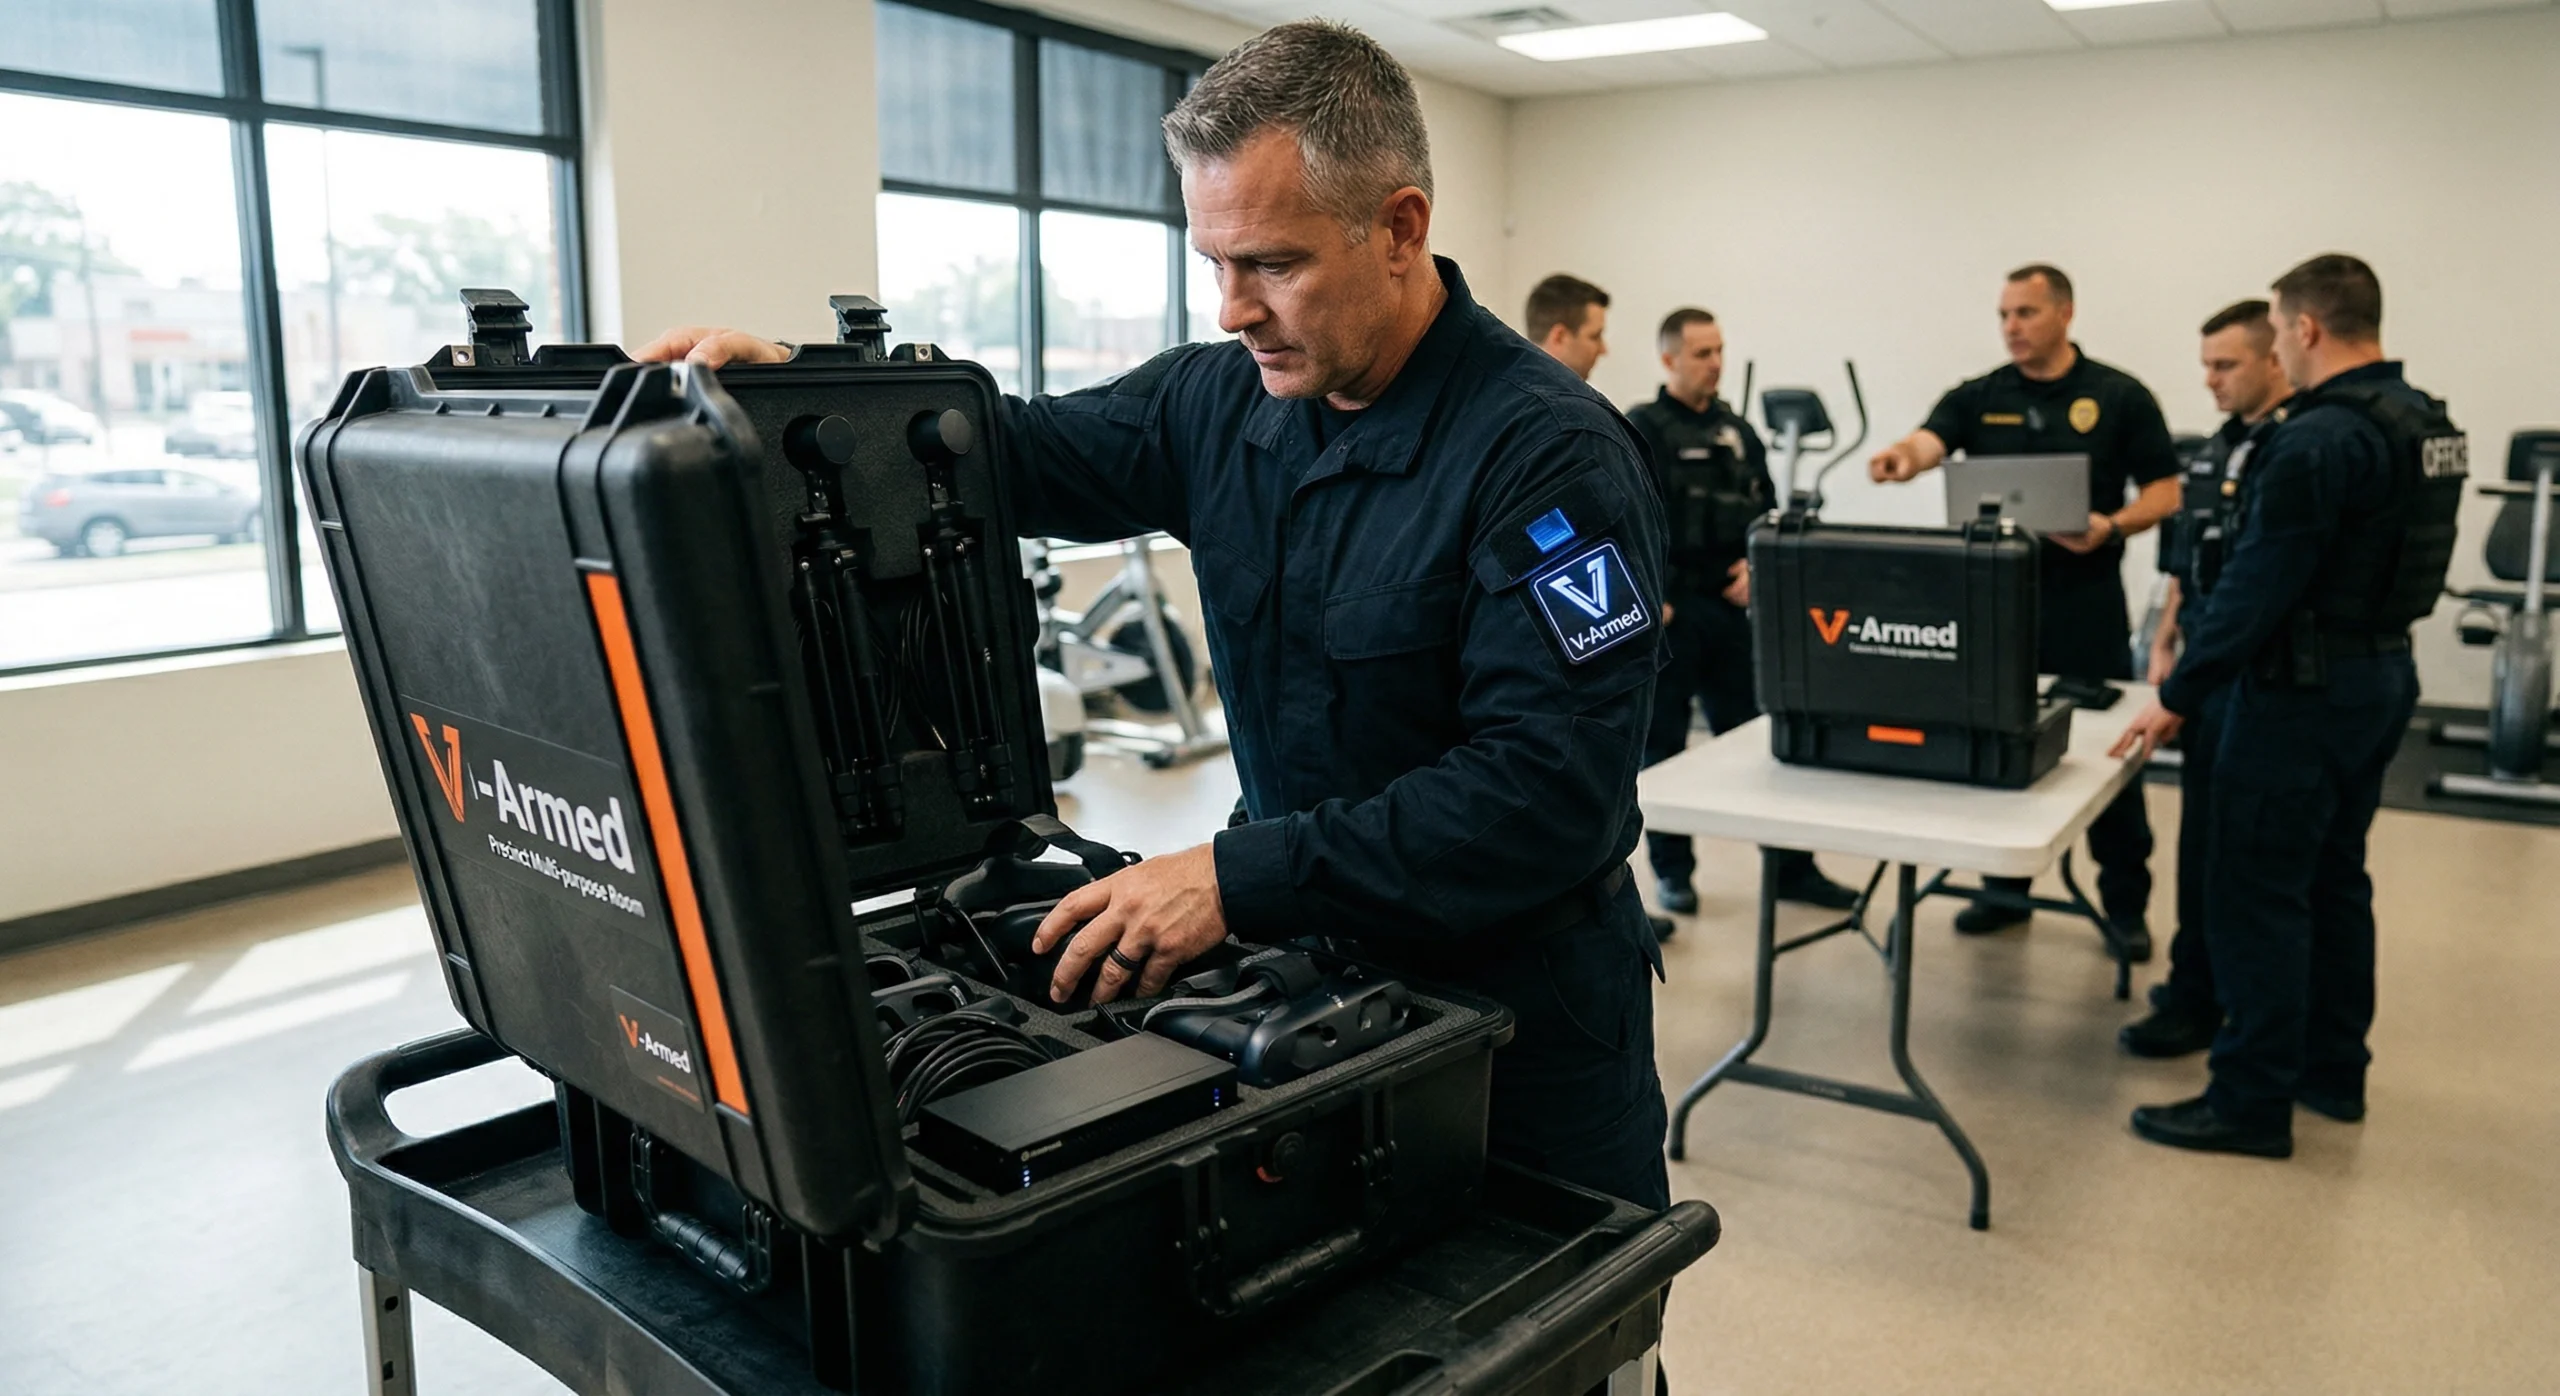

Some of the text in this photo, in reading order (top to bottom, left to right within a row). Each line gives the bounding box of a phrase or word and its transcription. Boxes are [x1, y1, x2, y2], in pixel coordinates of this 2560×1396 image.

[1569, 603, 1643, 651] V-Armed
[1808, 607, 1958, 648] V-Armed
[619, 1013, 691, 1073] V-Armed
